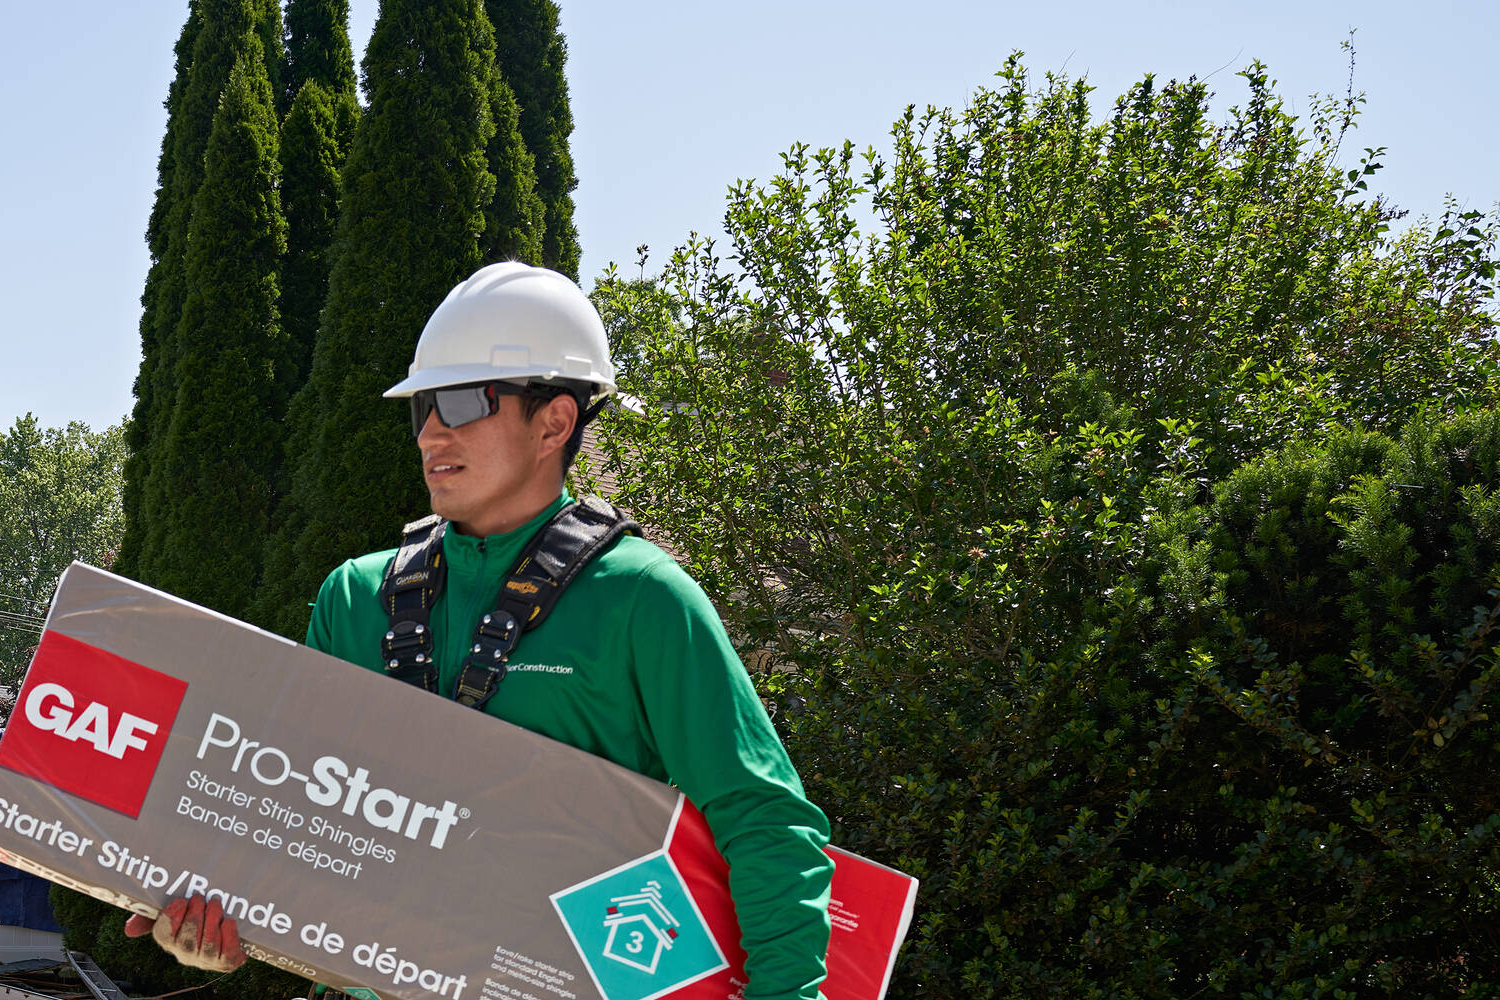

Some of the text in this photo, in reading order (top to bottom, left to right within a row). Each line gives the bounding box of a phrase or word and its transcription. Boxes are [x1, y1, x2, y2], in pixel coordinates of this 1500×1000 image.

[24, 682, 159, 760] GAF
[186, 769, 397, 864] Starter Strip Shingles
[176, 795, 363, 880] Bande de départ
[626, 931, 645, 955] 3
[278, 957, 316, 976] Strip
[299, 921, 345, 955] de
[352, 941, 468, 1000] départ
[494, 954, 564, 986] for standard English
[534, 961, 558, 974] starter
[558, 971, 574, 980] strip
[485, 978, 510, 992] Bande
[510, 989, 521, 997] de
[491, 963, 507, 973] and
[546, 984, 576, 999] shingles
